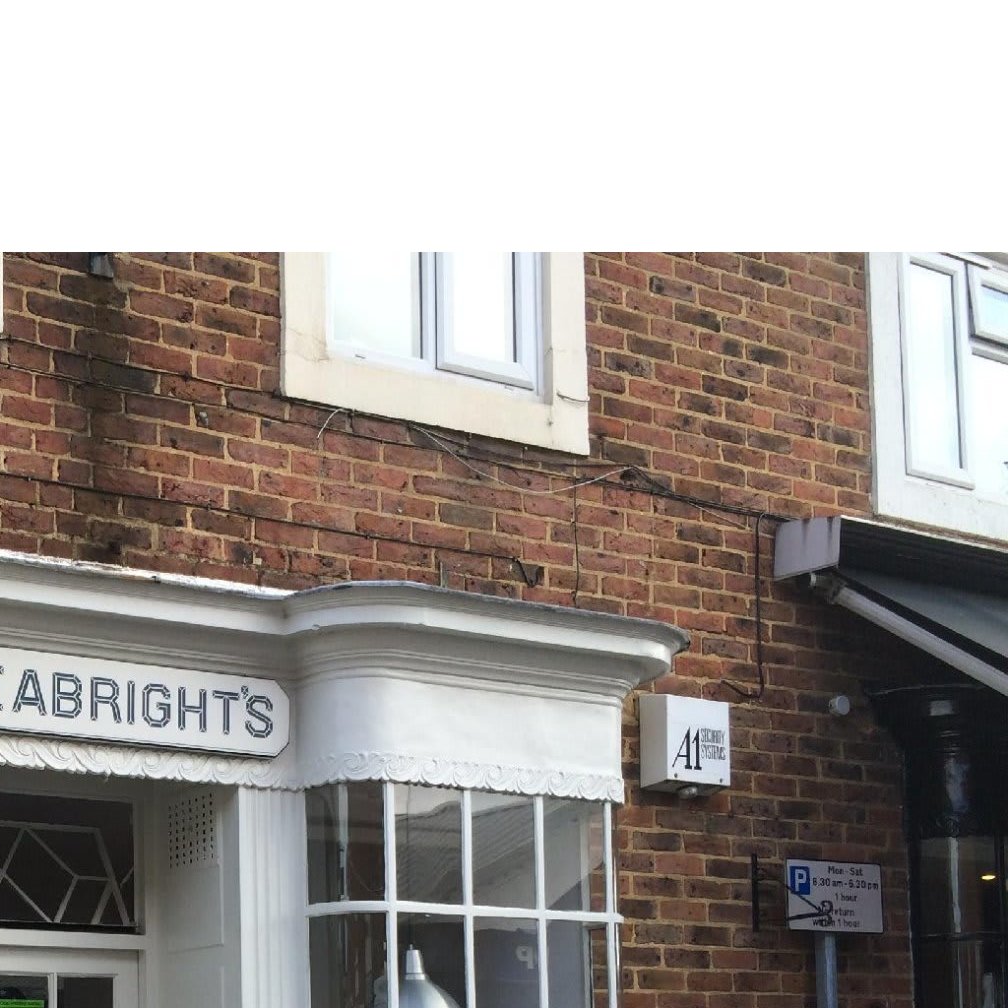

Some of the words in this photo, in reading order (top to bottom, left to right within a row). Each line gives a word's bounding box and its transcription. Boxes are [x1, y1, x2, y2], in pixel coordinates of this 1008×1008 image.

[672, 726, 702, 771] A1
[700, 743, 726, 760] SYSTEMS
[828, 866, 844, 875] Mon
[849, 867, 864, 876] Sat
[795, 869, 807, 892] P
[841, 893, 858, 902] hour
